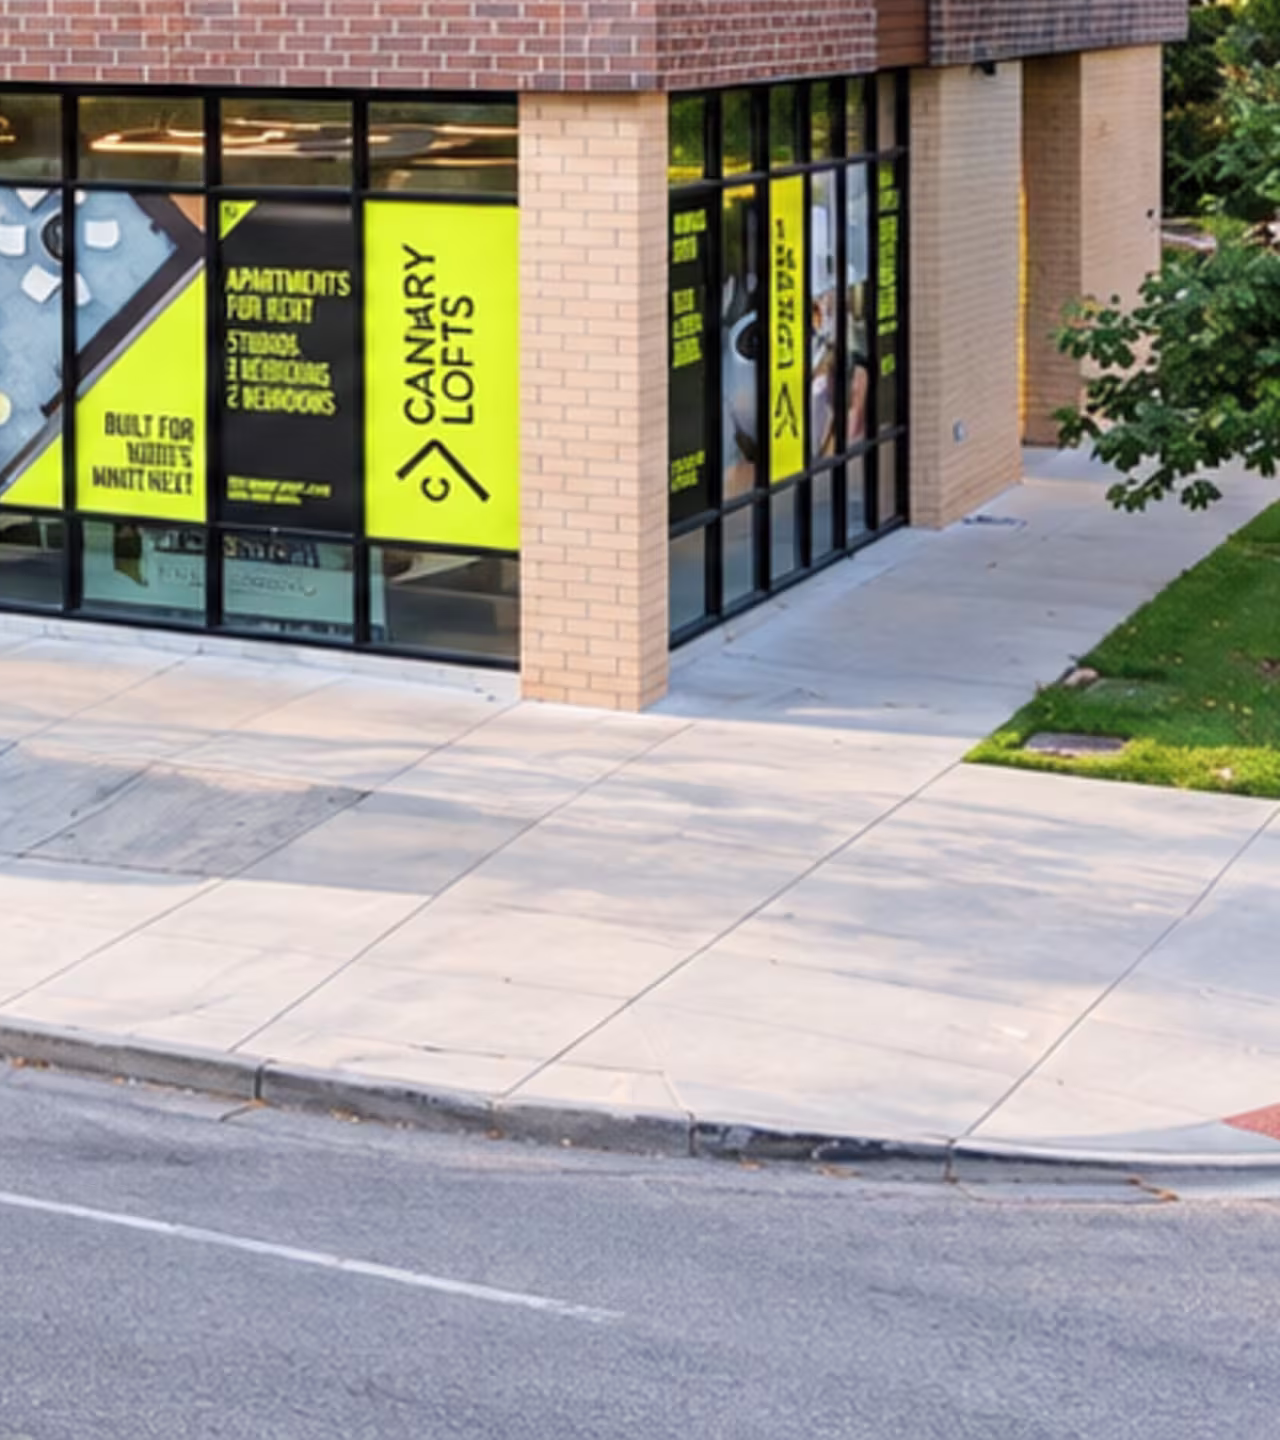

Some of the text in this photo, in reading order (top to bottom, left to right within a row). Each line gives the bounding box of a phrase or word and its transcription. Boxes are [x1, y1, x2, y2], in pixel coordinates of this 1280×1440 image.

[401, 243, 436, 425] CANARY
[440, 295, 475, 425] LOFTS
[158, 414, 194, 444] FOR
